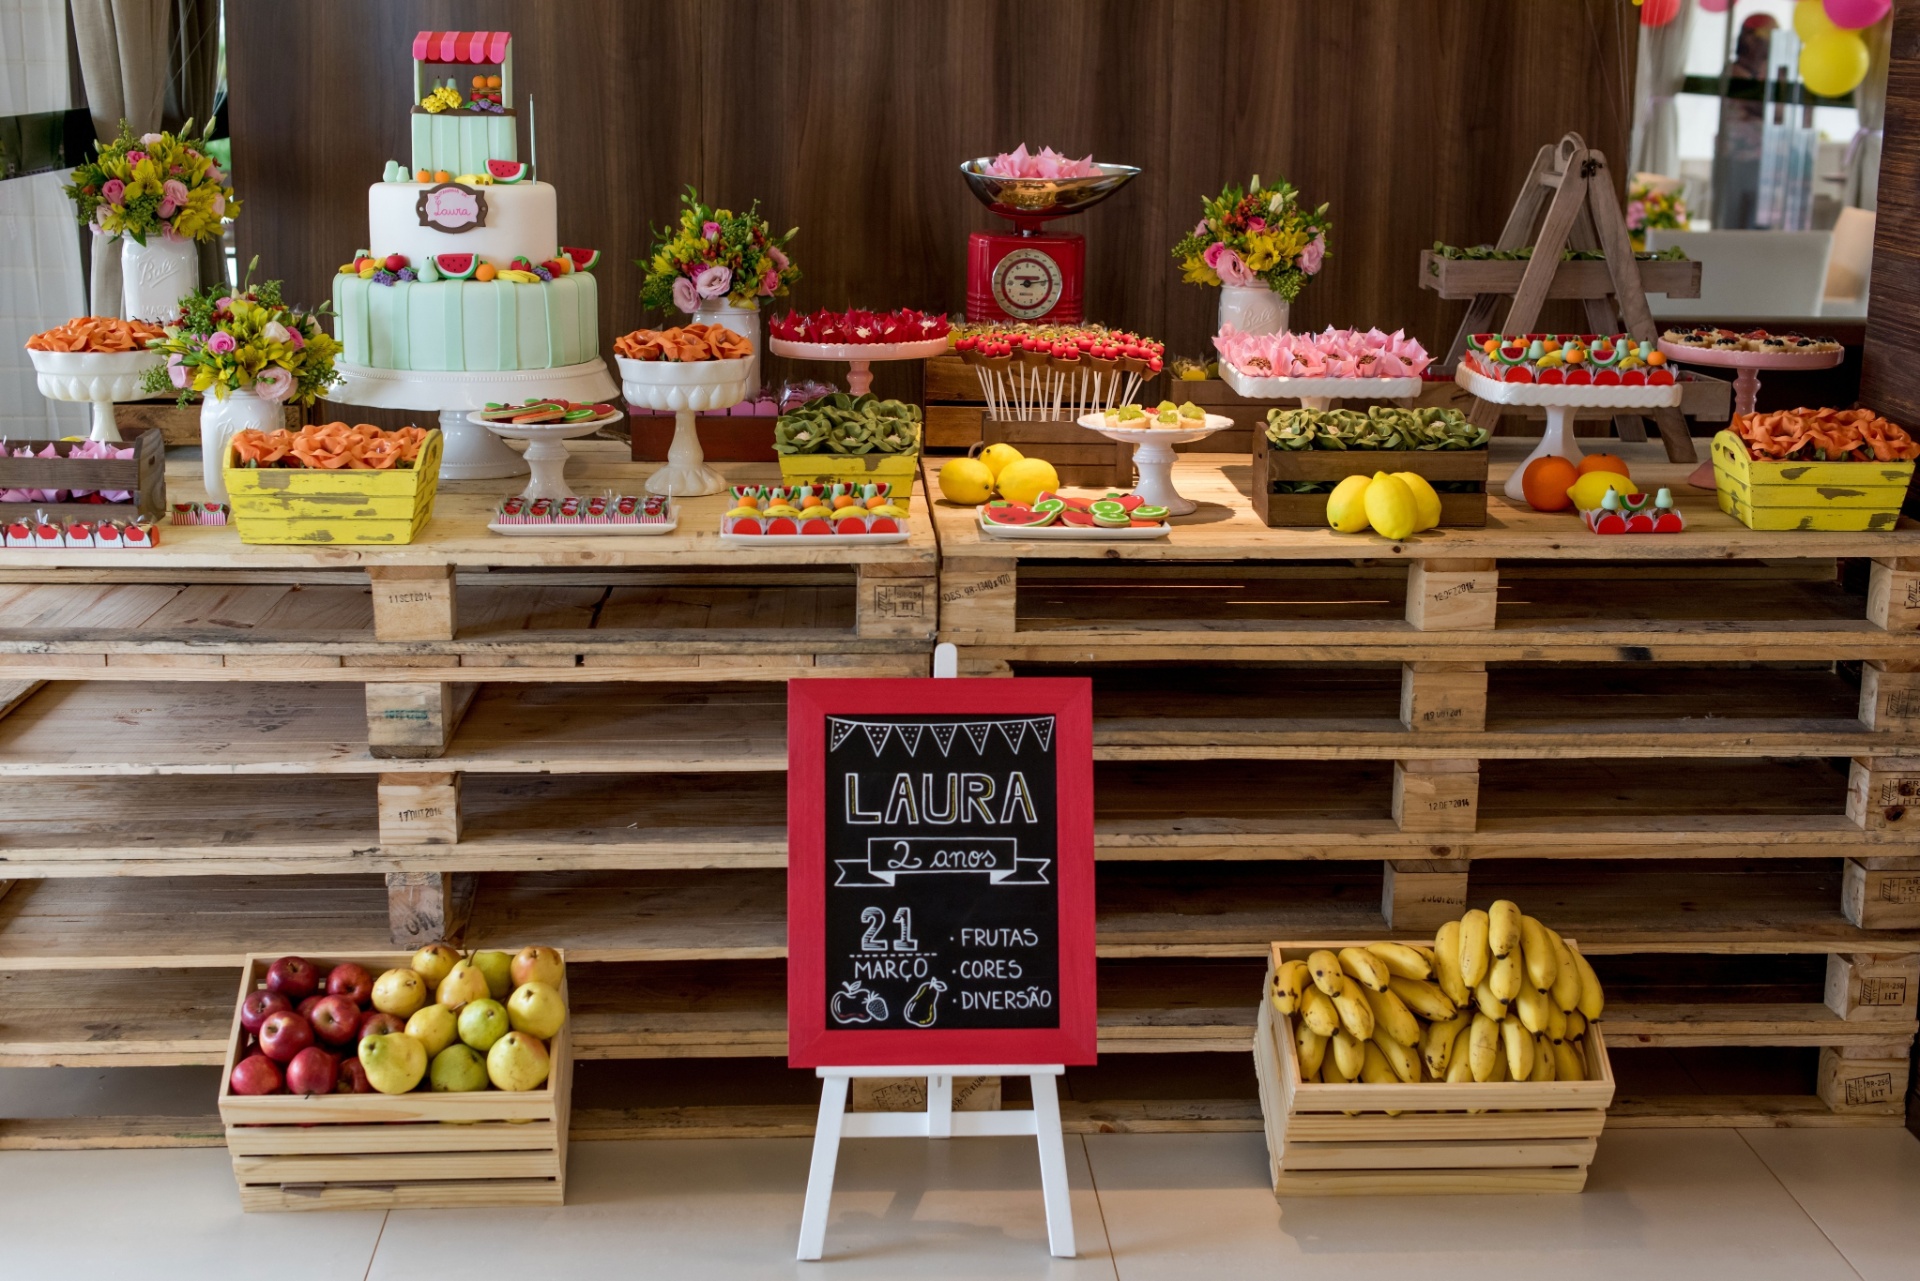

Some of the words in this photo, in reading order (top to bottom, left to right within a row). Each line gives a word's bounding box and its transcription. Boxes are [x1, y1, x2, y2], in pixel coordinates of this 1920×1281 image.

[434, 200, 472, 217] Laura
[844, 771, 1038, 825] LAURA
[887, 841, 922, 869] 2
[929, 848, 997, 869] anos
[860, 906, 918, 952] 21
[961, 928, 1039, 948] FRUTAS
[854, 957, 929, 982] MARÇO
[960, 959, 1023, 979] CORES
[961, 986, 1052, 1010] DIVERSÃO
[1884, 992, 1899, 1000] HT
[1871, 1088, 1885, 1098] HT
